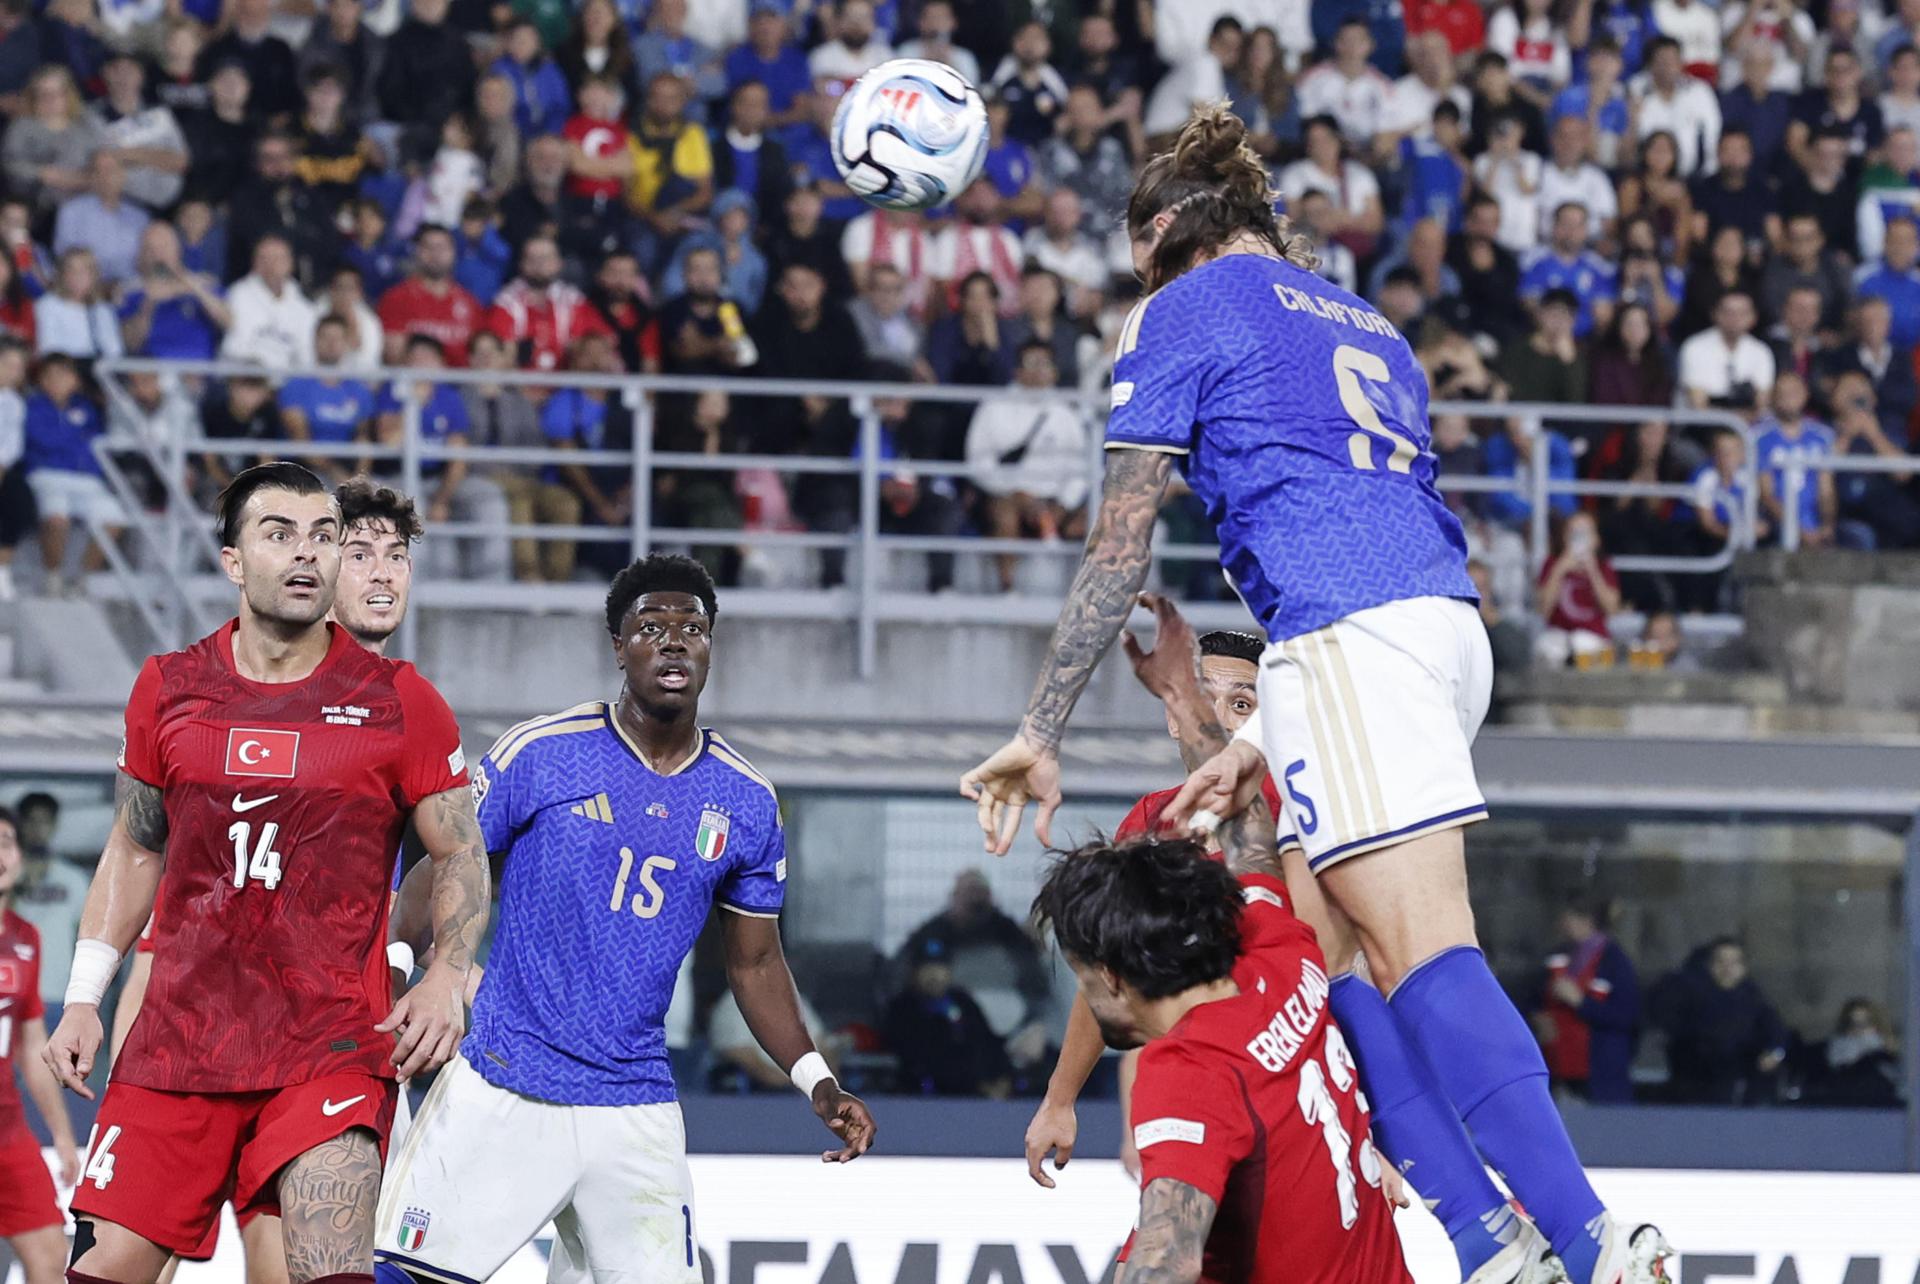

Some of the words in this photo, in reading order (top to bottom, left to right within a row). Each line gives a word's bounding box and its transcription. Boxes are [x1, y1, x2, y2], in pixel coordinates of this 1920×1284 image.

[1284, 758, 1318, 836] 5
[228, 821, 282, 891] 14
[609, 846, 677, 919] 15
[1246, 1010, 1305, 1073] EREN
[404, 1214, 427, 1227] ITALIA
